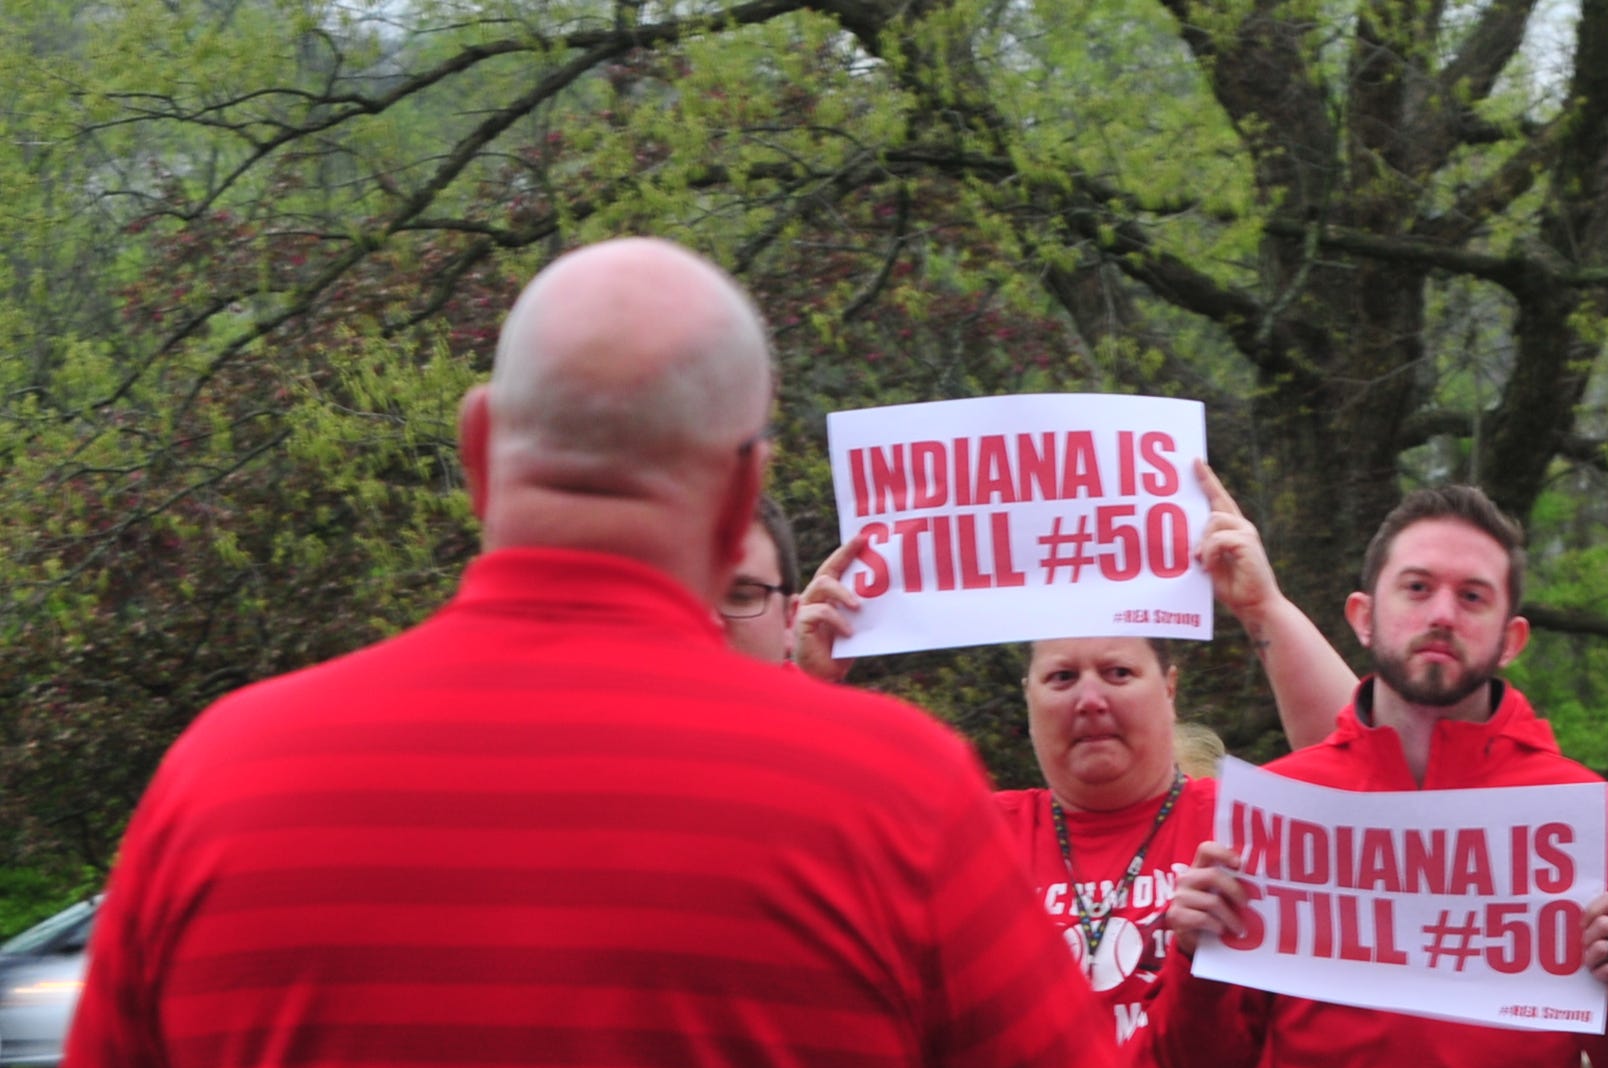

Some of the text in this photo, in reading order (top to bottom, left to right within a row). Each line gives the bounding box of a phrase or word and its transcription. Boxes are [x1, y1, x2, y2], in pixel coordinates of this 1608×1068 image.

[848, 430, 1180, 517] INDIANA IS
[852, 502, 1191, 599] STILL #50
[1154, 609, 1200, 627] Strong
[1231, 800, 1576, 896] INDIANA IS
[1220, 878, 1585, 976] STILL #50
[1542, 1006, 1592, 1023] Strong
